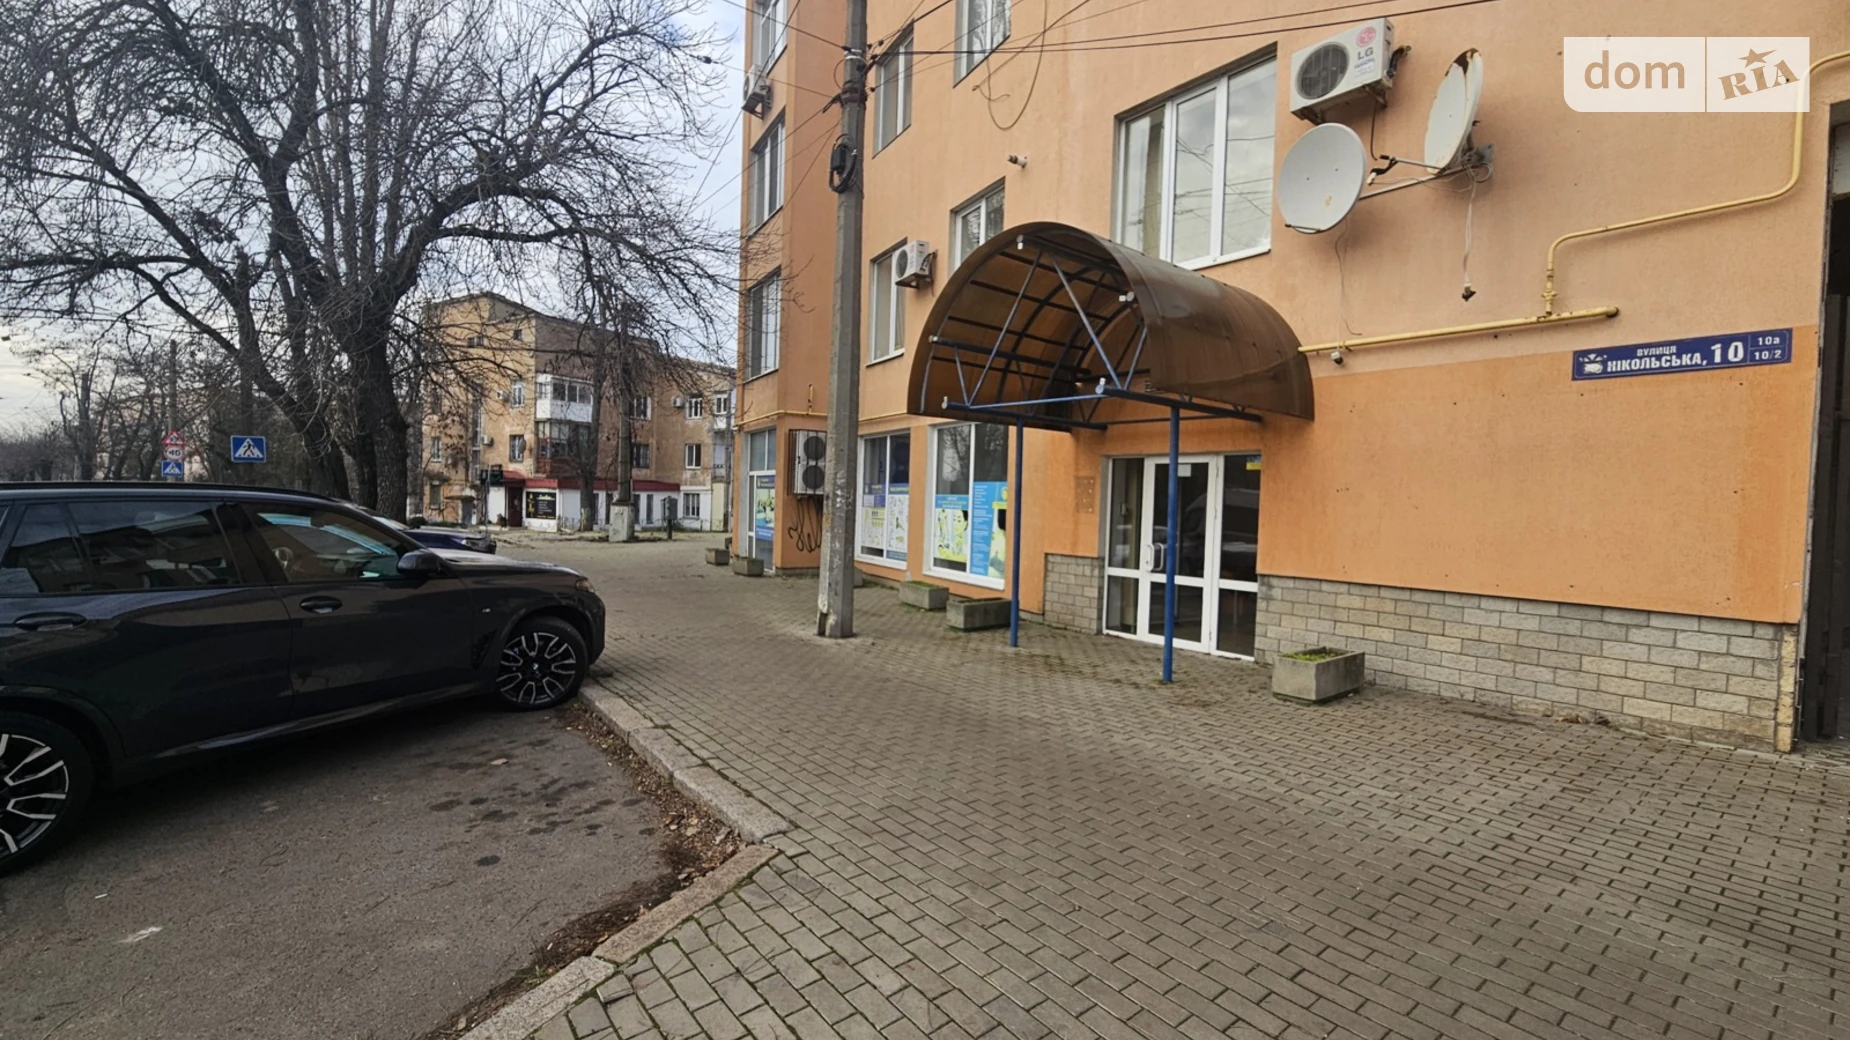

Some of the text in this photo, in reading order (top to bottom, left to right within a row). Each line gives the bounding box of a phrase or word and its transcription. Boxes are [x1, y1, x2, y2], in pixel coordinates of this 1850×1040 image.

[1357, 47, 1374, 60] LG
[1607, 341, 1744, 372] НІКОЛЬСЬКА, 10
[1754, 349, 1782, 360] 10/2
[169, 449, 181, 457] 40
